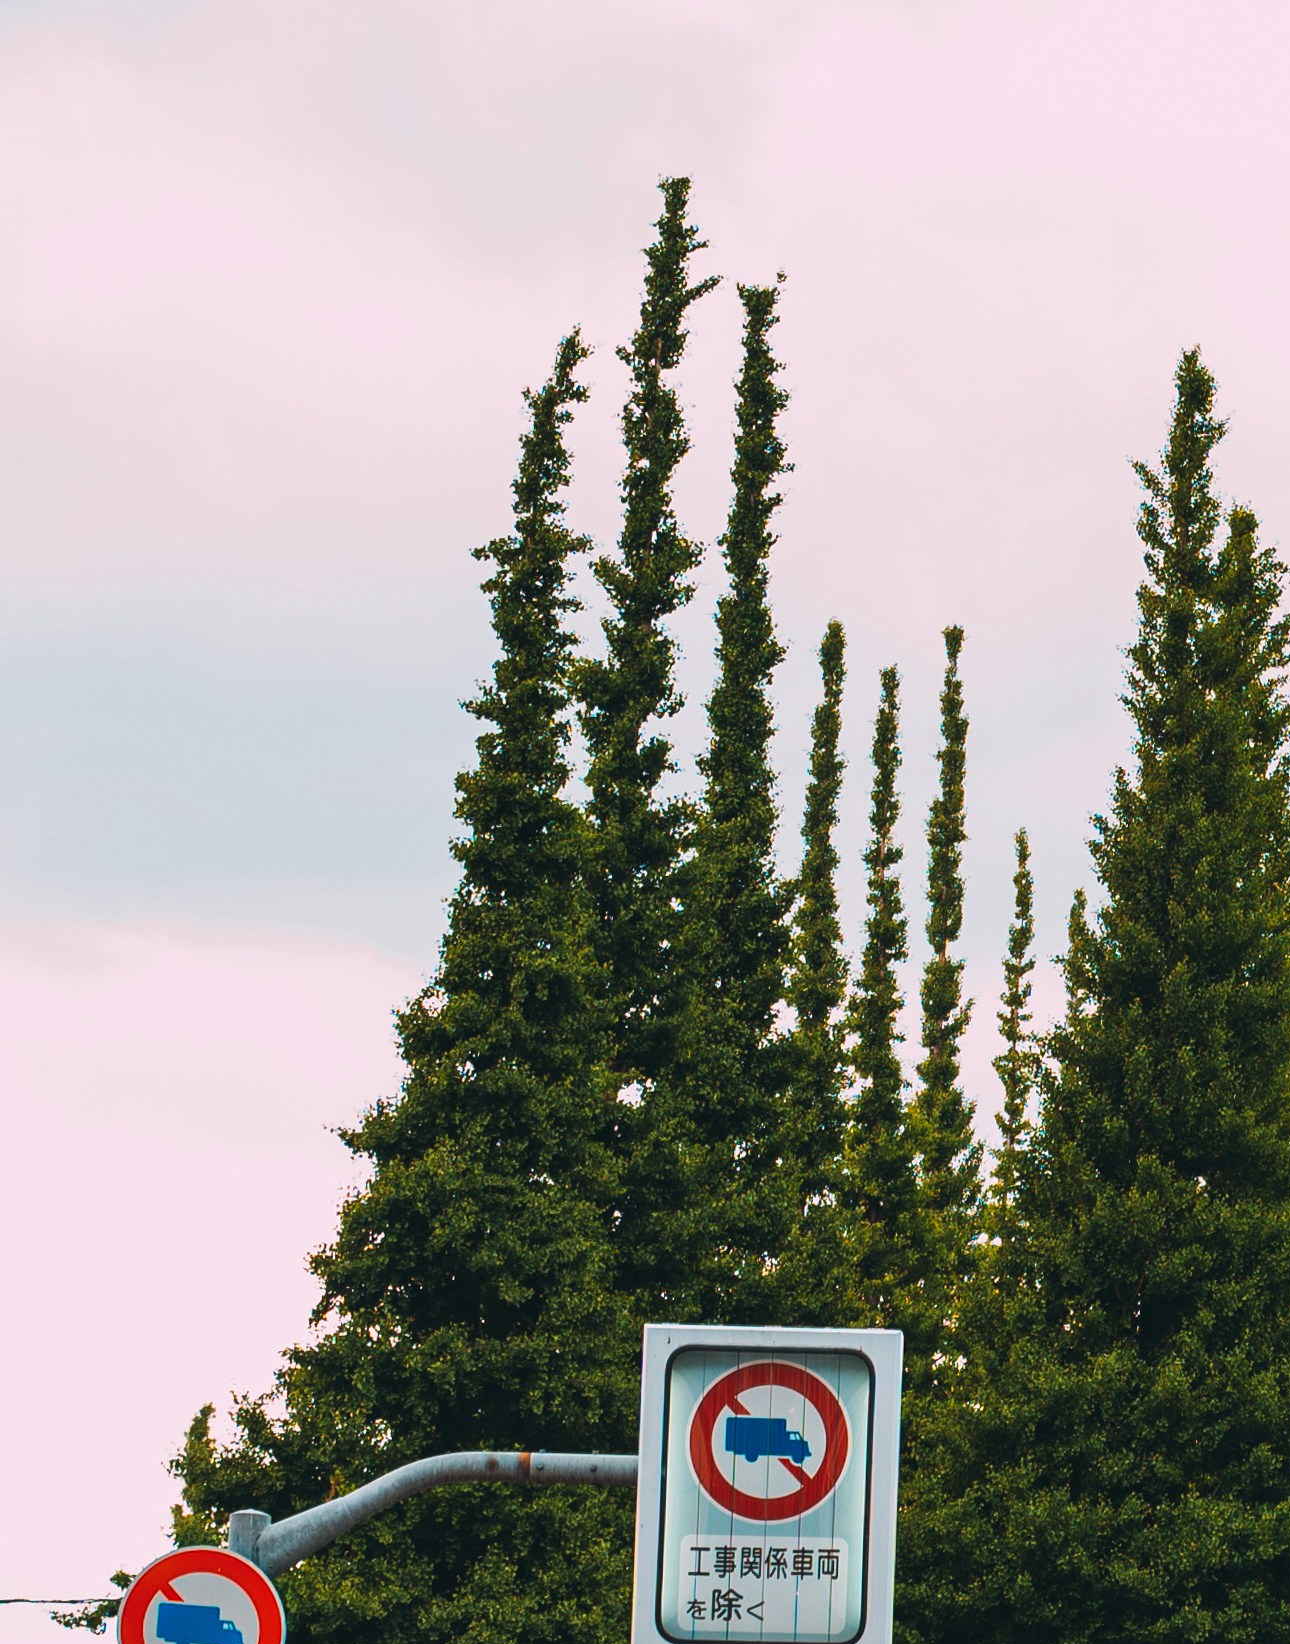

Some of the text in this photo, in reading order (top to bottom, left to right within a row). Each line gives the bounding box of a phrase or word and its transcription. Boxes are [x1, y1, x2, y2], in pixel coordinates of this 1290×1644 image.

[687, 1545, 841, 1580] 工事関係車両
[686, 1588, 765, 1621] を除く
